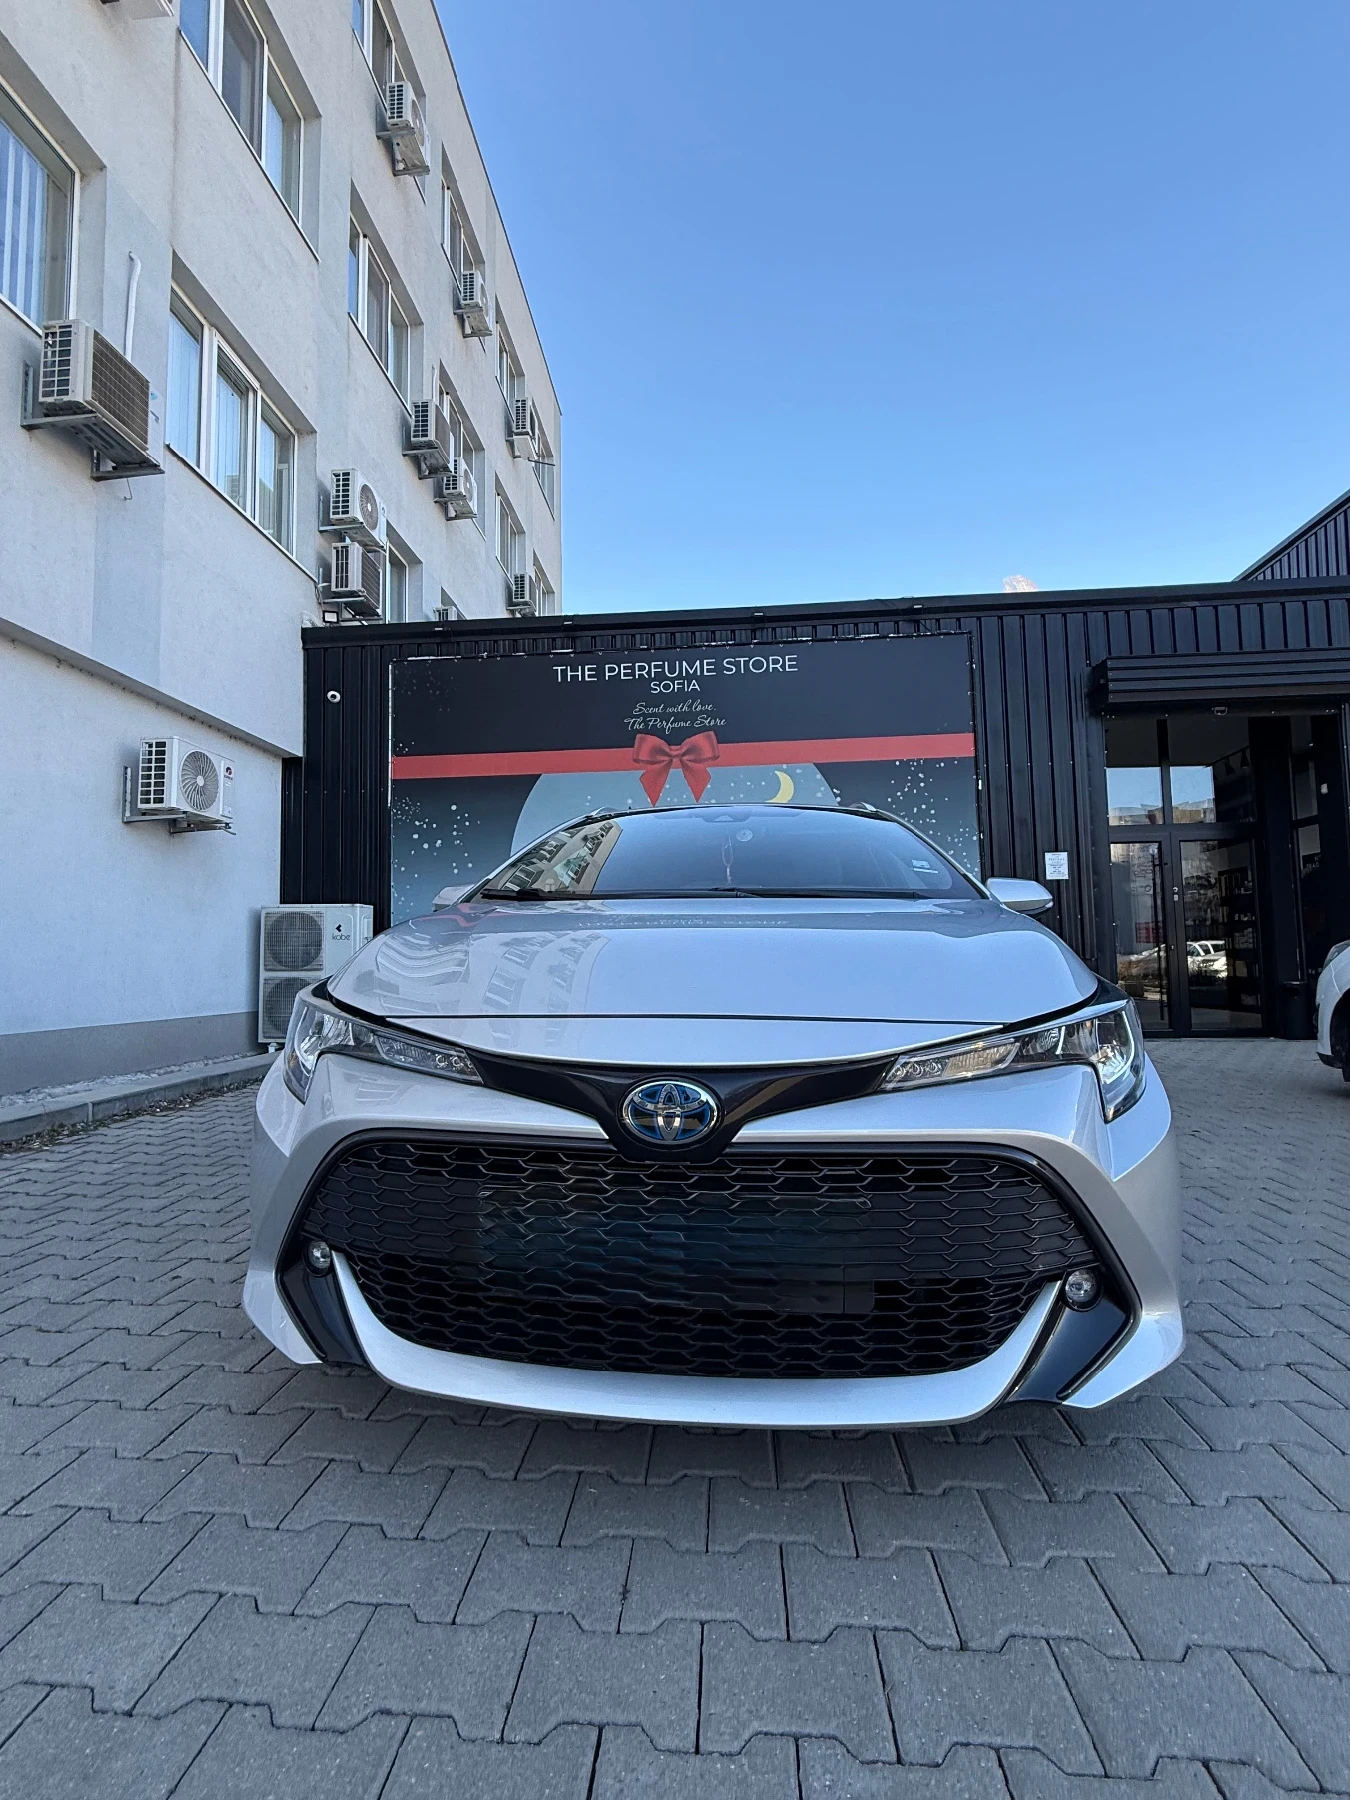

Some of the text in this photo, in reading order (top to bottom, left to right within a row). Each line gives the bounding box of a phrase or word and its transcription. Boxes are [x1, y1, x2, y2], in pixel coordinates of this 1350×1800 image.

[552, 655, 799, 683] THE PERFUME STORE
[650, 679, 701, 694] SOFIA
[632, 699, 717, 715] Scent with love.
[624, 714, 727, 735] The Perfume Store
[331, 933, 351, 941] kobe
